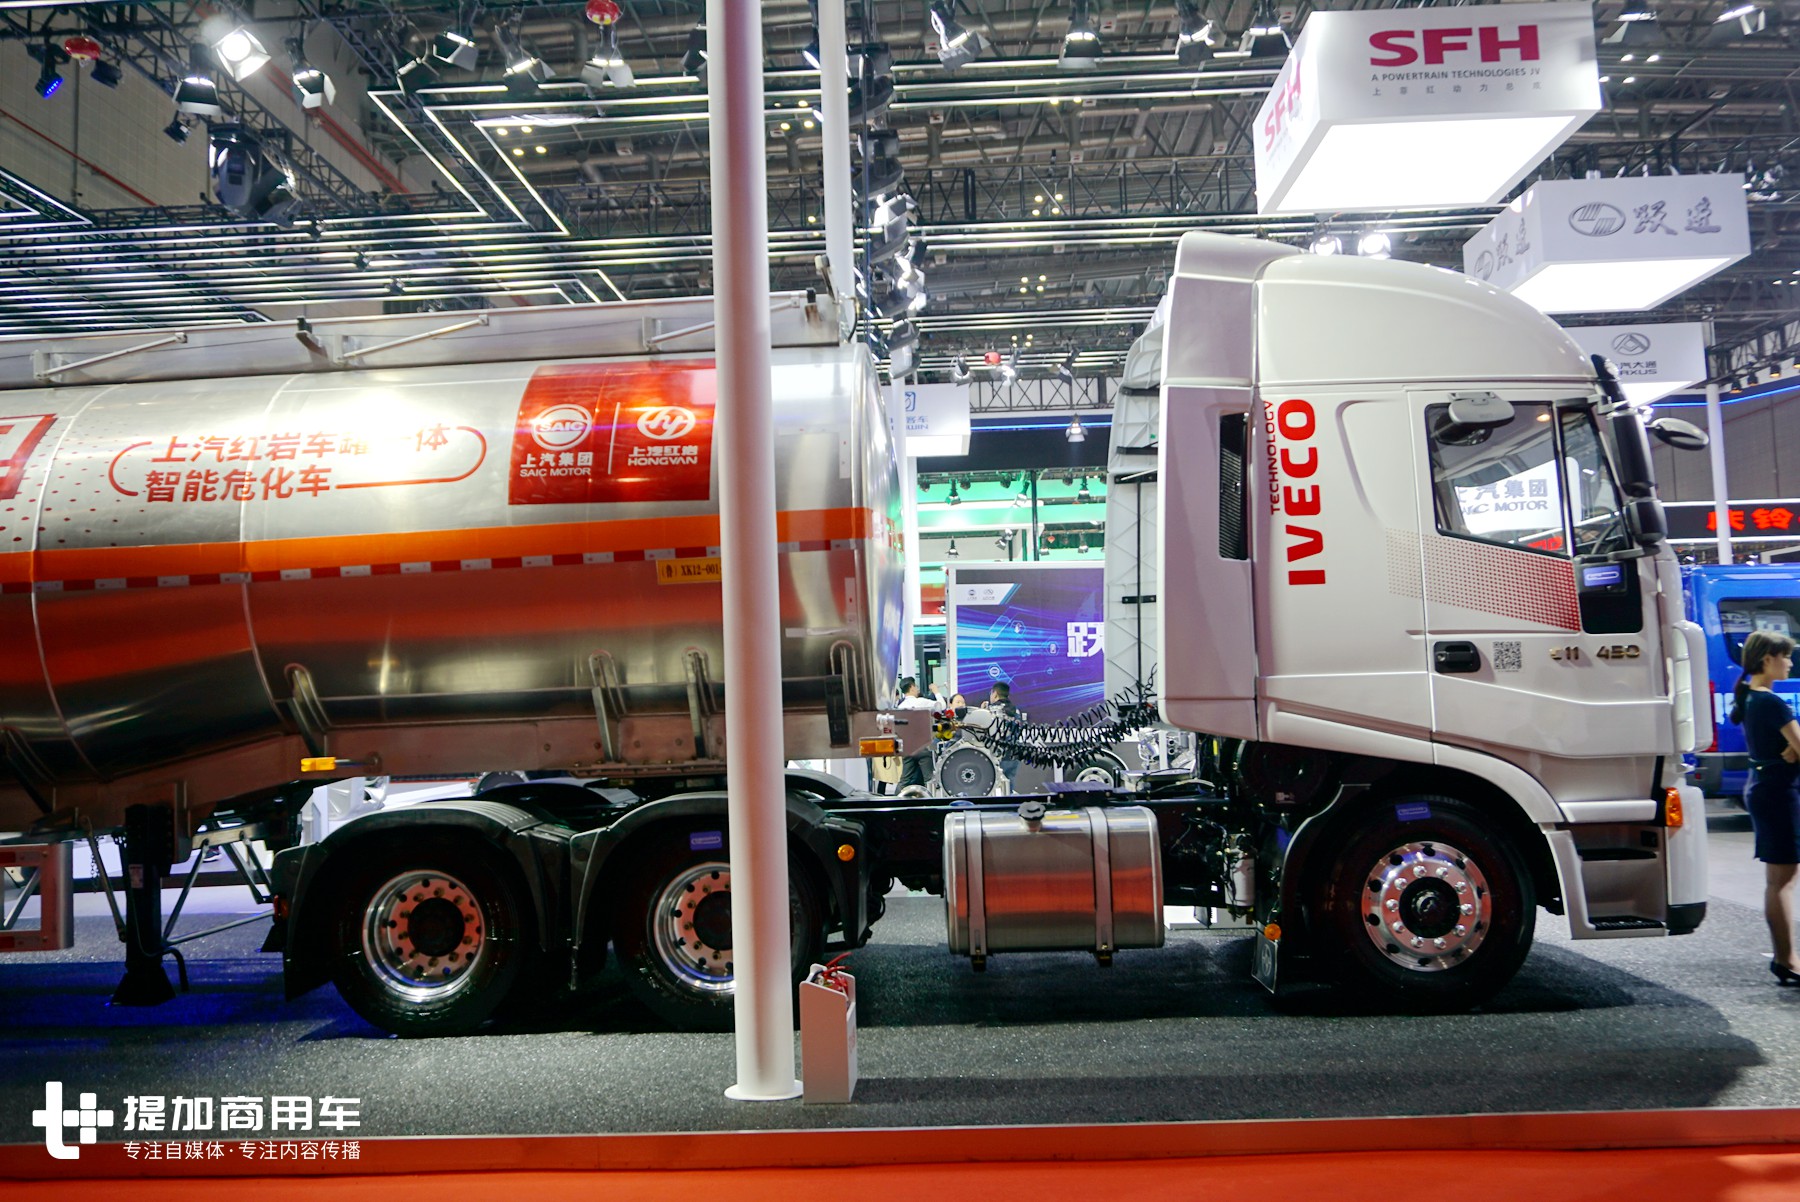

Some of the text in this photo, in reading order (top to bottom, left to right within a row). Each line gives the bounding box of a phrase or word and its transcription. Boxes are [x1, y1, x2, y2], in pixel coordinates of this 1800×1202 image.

[1369, 25, 1540, 67] SFH
[1382, 70, 1448, 81] POWERTRAIN
[1452, 68, 1526, 79] TECHNOLOGIES
[1616, 361, 1657, 370] 汽大通
[541, 421, 585, 432] SAIC
[520, 452, 593, 468] 上汽集团
[519, 467, 591, 478] SAIC MOTOR
[145, 464, 332, 503] 智能危化车
[1277, 399, 1326, 586] IVECO
[1495, 500, 1548, 512] MOTOR
[1706, 508, 1800, 531] 庆铃
[681, 563, 721, 576] XK12-001
